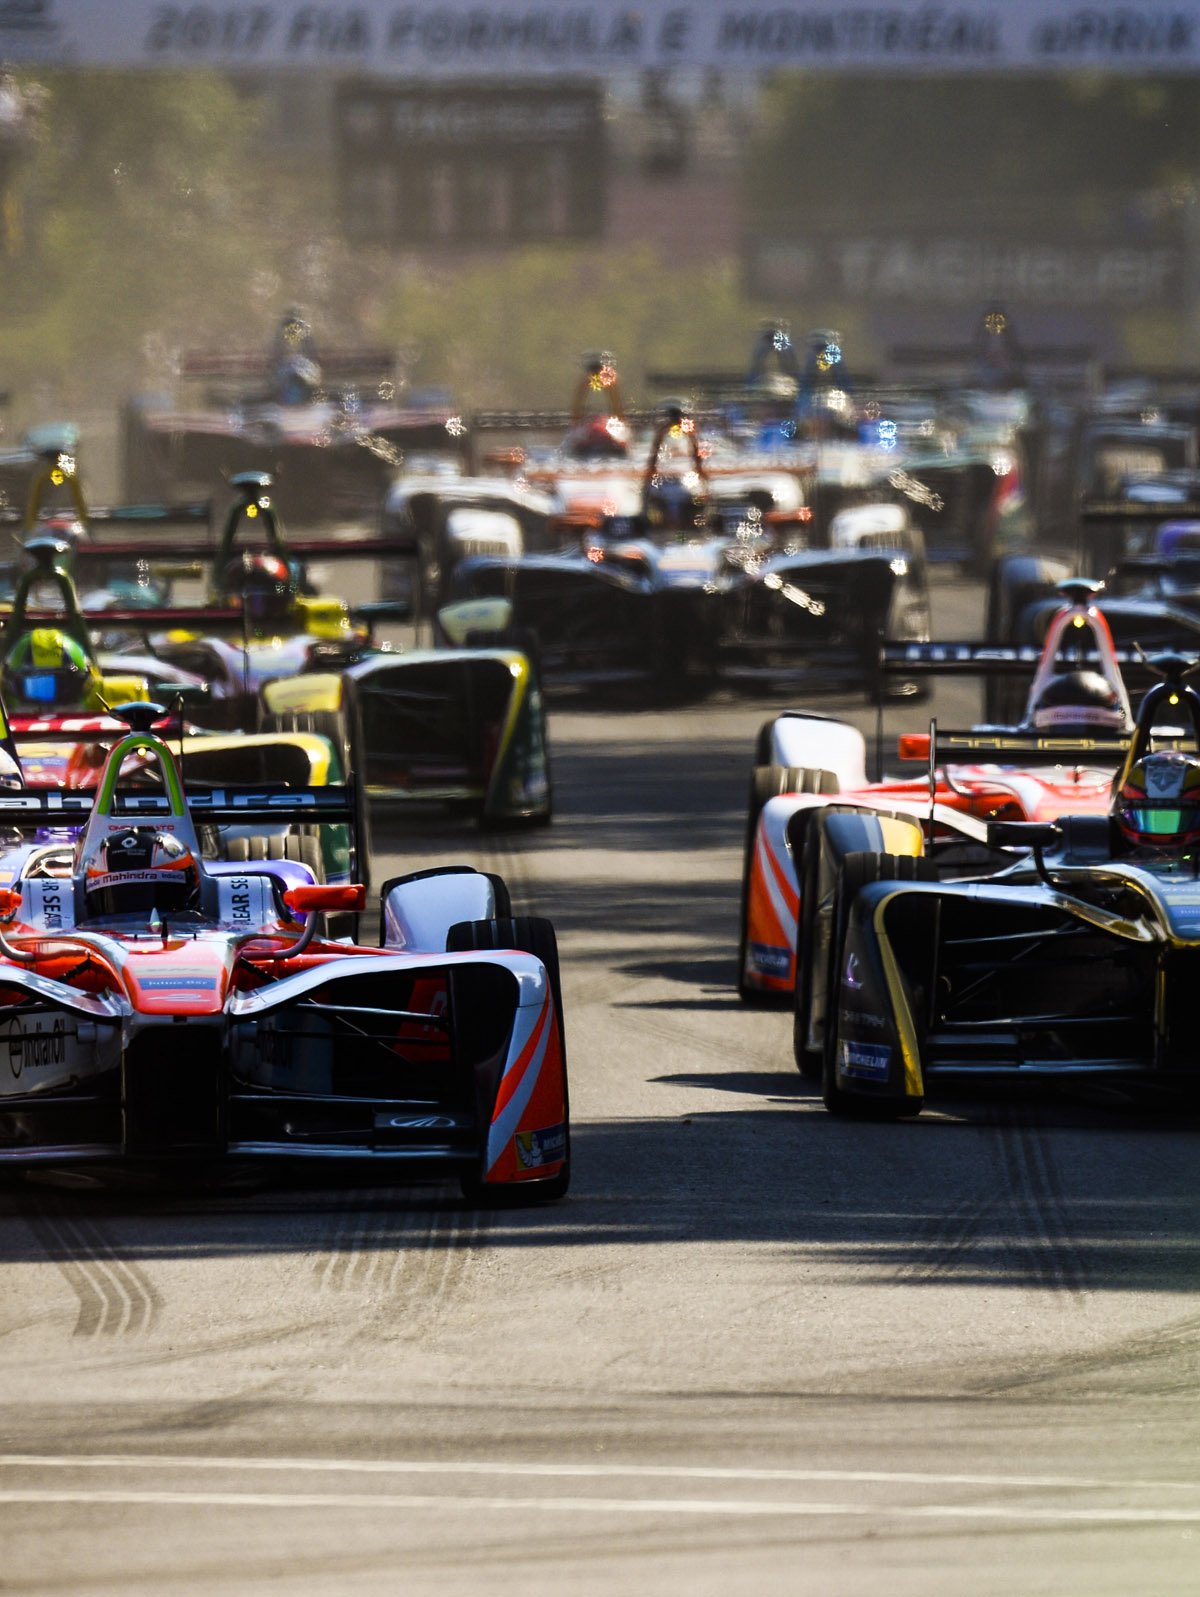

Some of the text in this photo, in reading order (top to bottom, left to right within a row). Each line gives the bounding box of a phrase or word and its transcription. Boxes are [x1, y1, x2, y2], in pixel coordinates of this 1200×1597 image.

[143, 8, 283, 53] 2017
[285, 10, 373, 53] FIA
[385, 10, 644, 53] FORMULA
[656, 11, 695, 53] E
